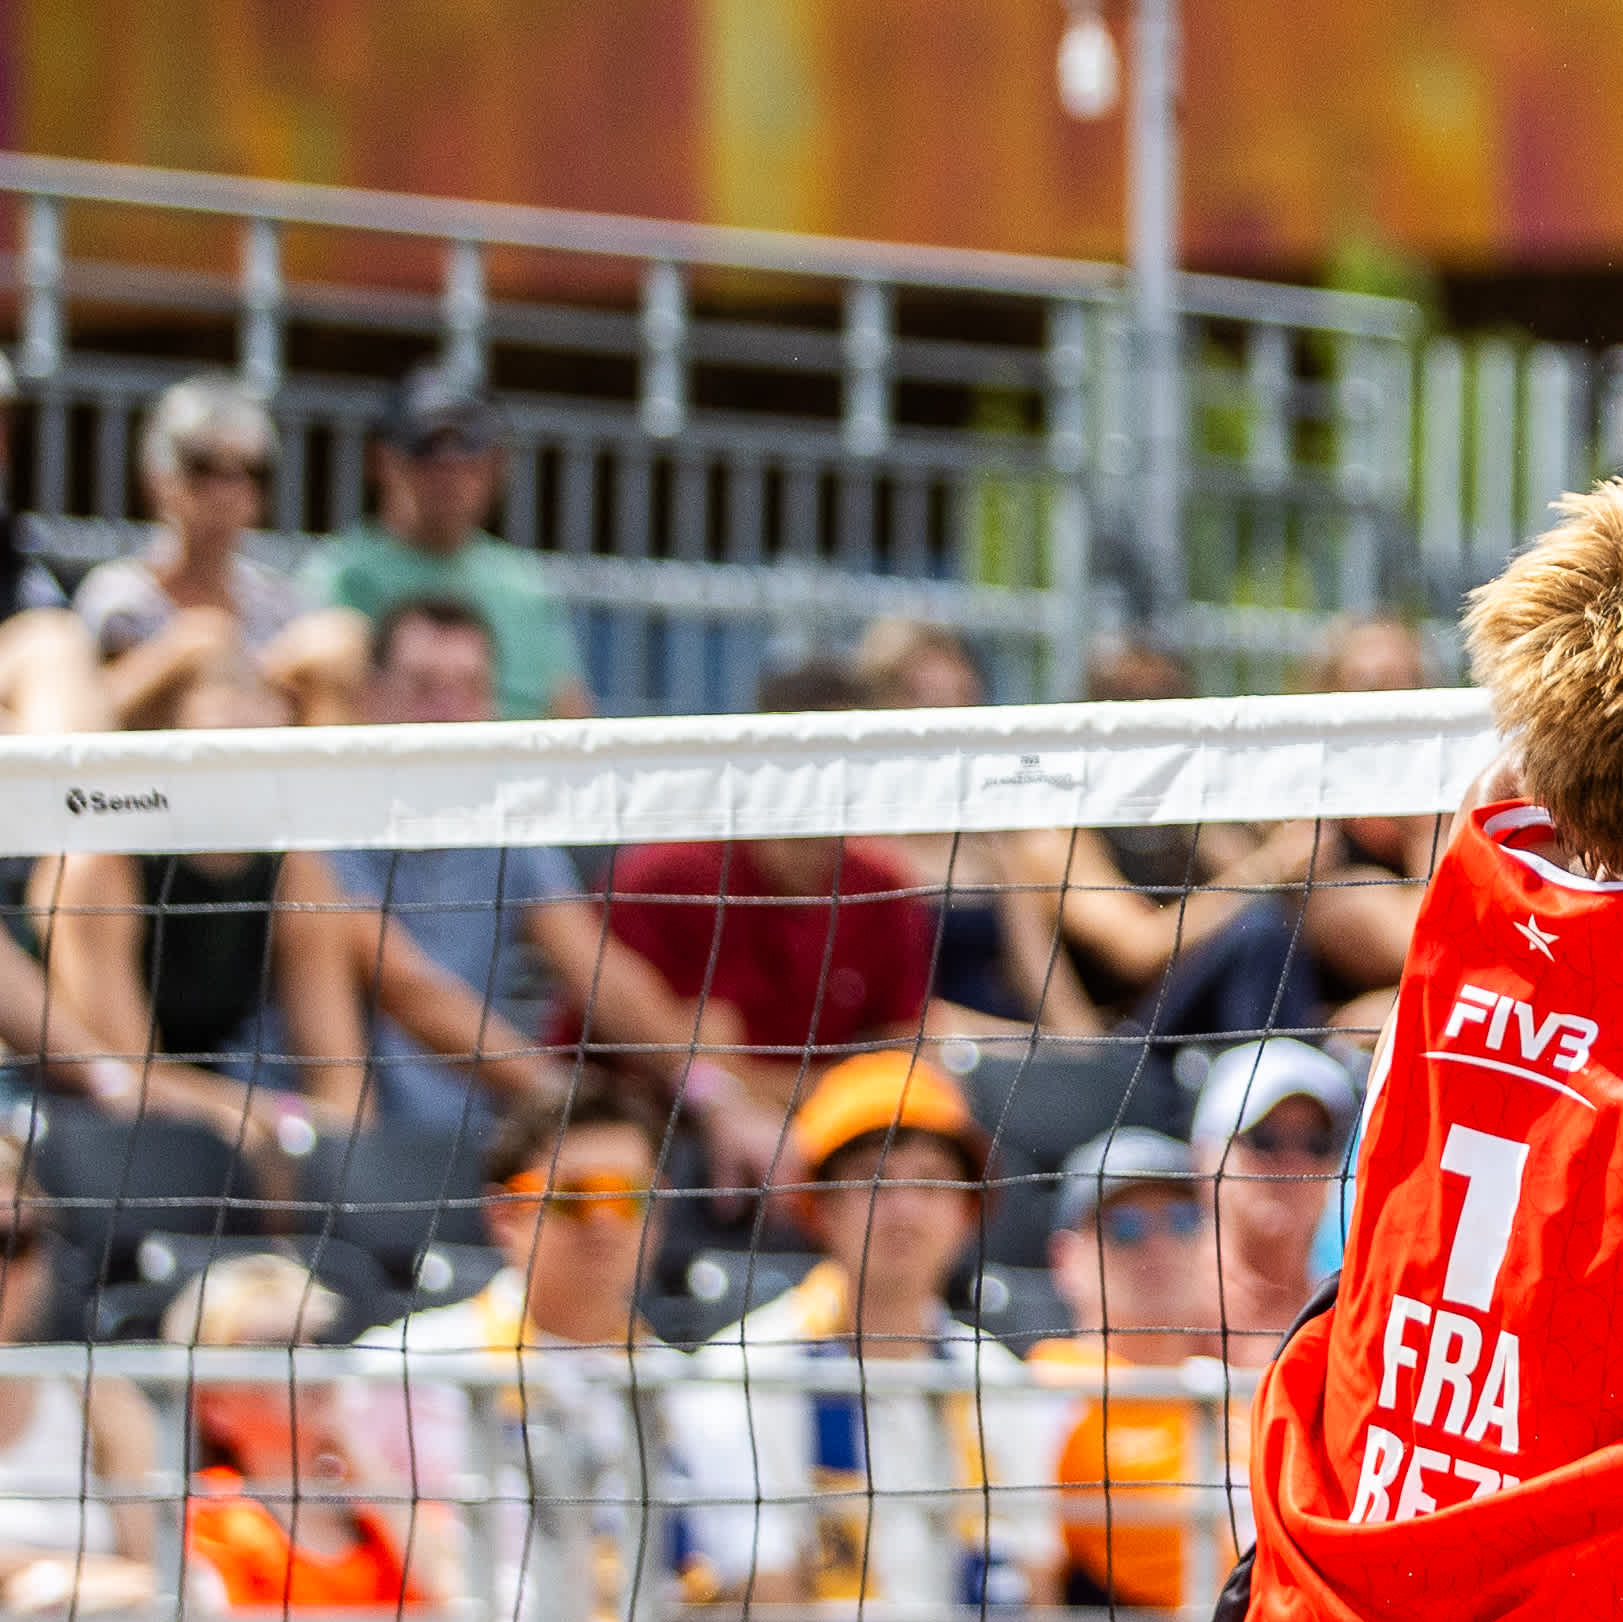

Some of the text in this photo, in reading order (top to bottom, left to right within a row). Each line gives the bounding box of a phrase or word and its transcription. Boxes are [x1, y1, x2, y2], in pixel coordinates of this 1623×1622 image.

[88, 787, 169, 814] Senoh
[1377, 1293, 1521, 1455] FRA
[1347, 1424, 1521, 1524] BE
